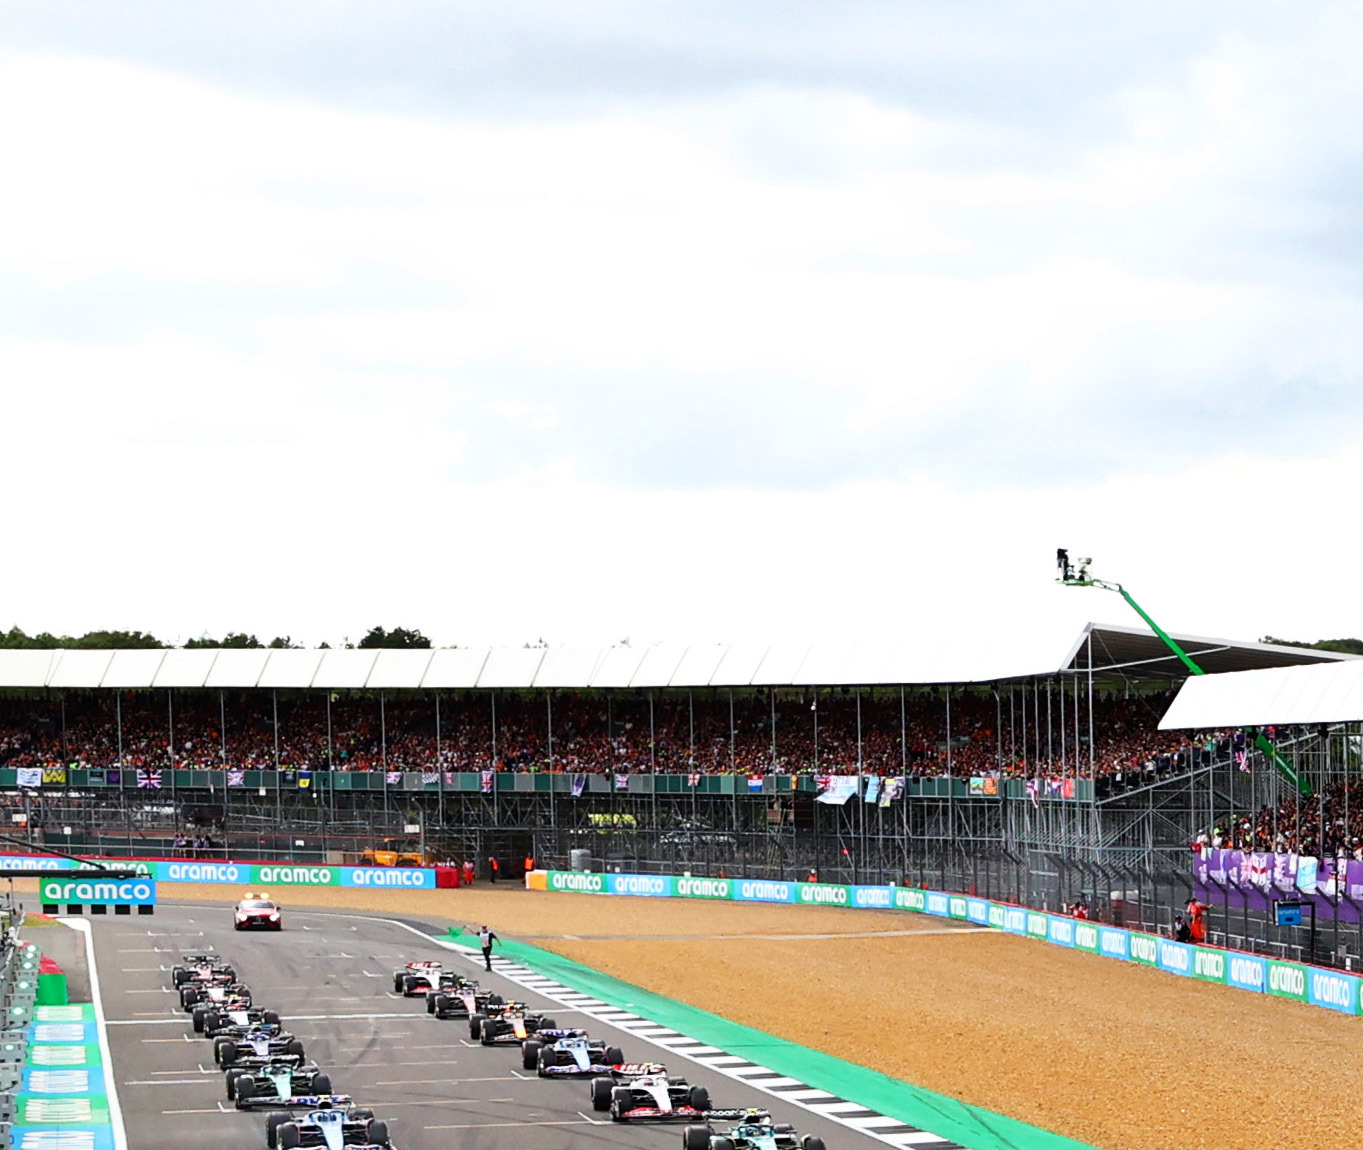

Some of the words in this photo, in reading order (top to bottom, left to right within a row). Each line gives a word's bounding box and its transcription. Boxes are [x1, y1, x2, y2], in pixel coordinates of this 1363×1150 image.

[169, 863, 239, 880] aramco
[260, 867, 331, 884] aramco
[353, 869, 425, 886] aramco
[553, 874, 602, 890] aramco
[615, 876, 664, 893] aramco
[678, 880, 728, 896] aramco
[742, 882, 789, 899] aramco
[45, 884, 150, 900] aramco
[802, 885, 847, 903] aramco
[1270, 965, 1304, 995] aramco
[1313, 973, 1350, 1007] aramco
